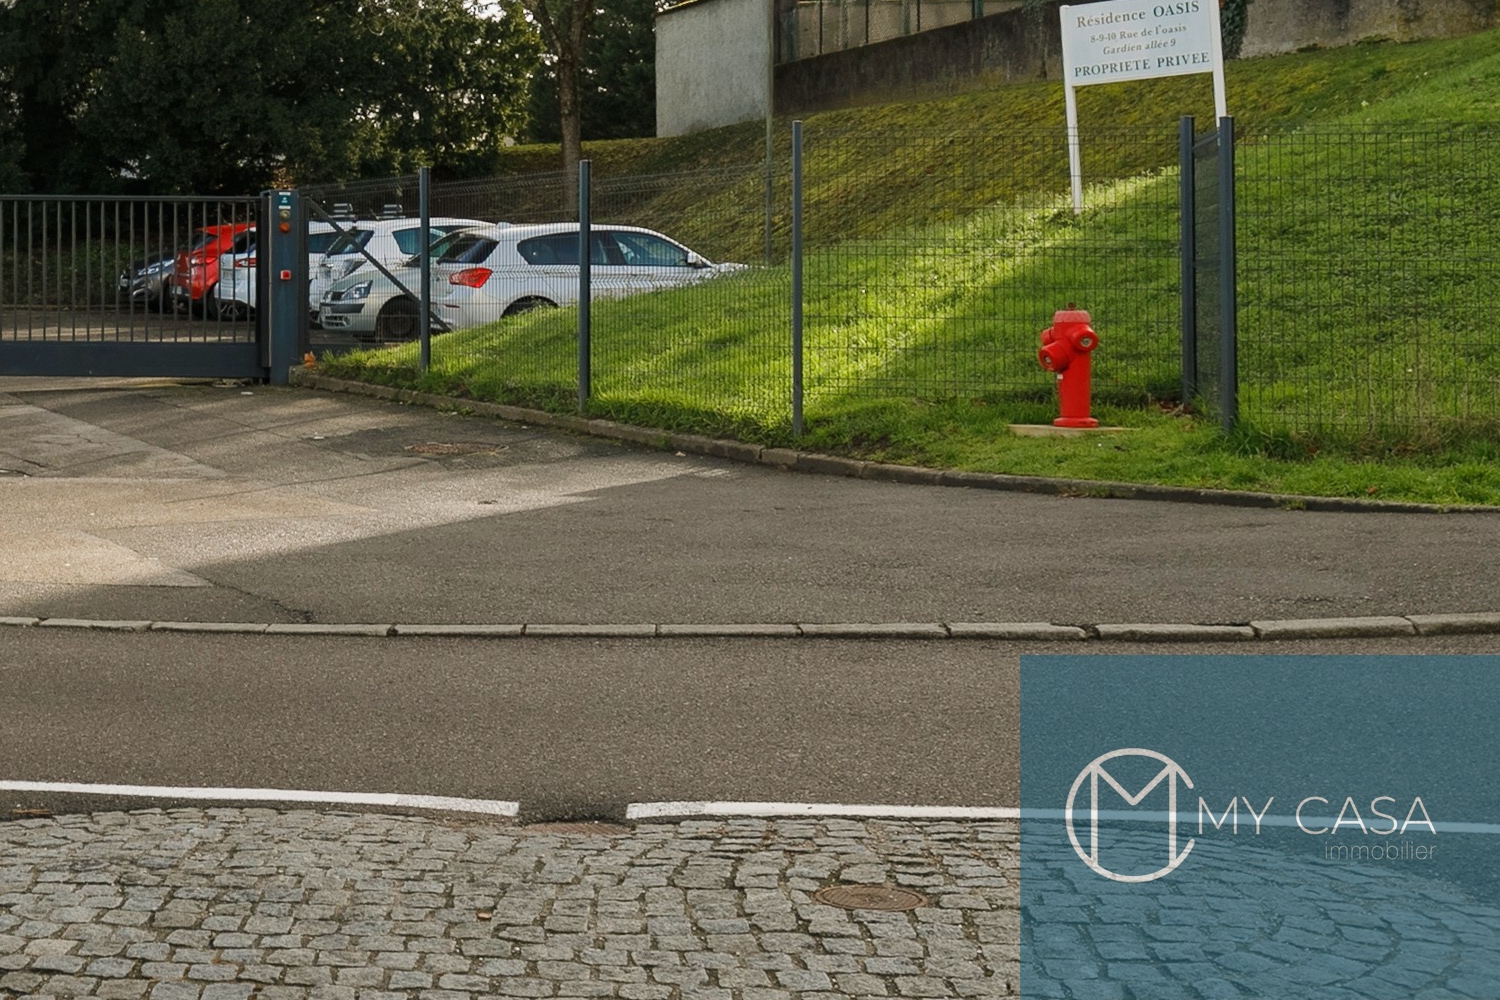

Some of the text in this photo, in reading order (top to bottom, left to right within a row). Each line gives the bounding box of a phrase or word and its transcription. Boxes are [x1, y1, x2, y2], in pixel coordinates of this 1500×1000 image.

[1077, 0, 1199, 28] Résidence OASIS
[1119, 30, 1138, 40] Rue
[1140, 28, 1153, 37] de
[1155, 24, 1187, 36] l'oasis
[1102, 38, 1177, 55] Gardien allée 9
[1074, 52, 1210, 77] PROPRIETE PRIVEE
